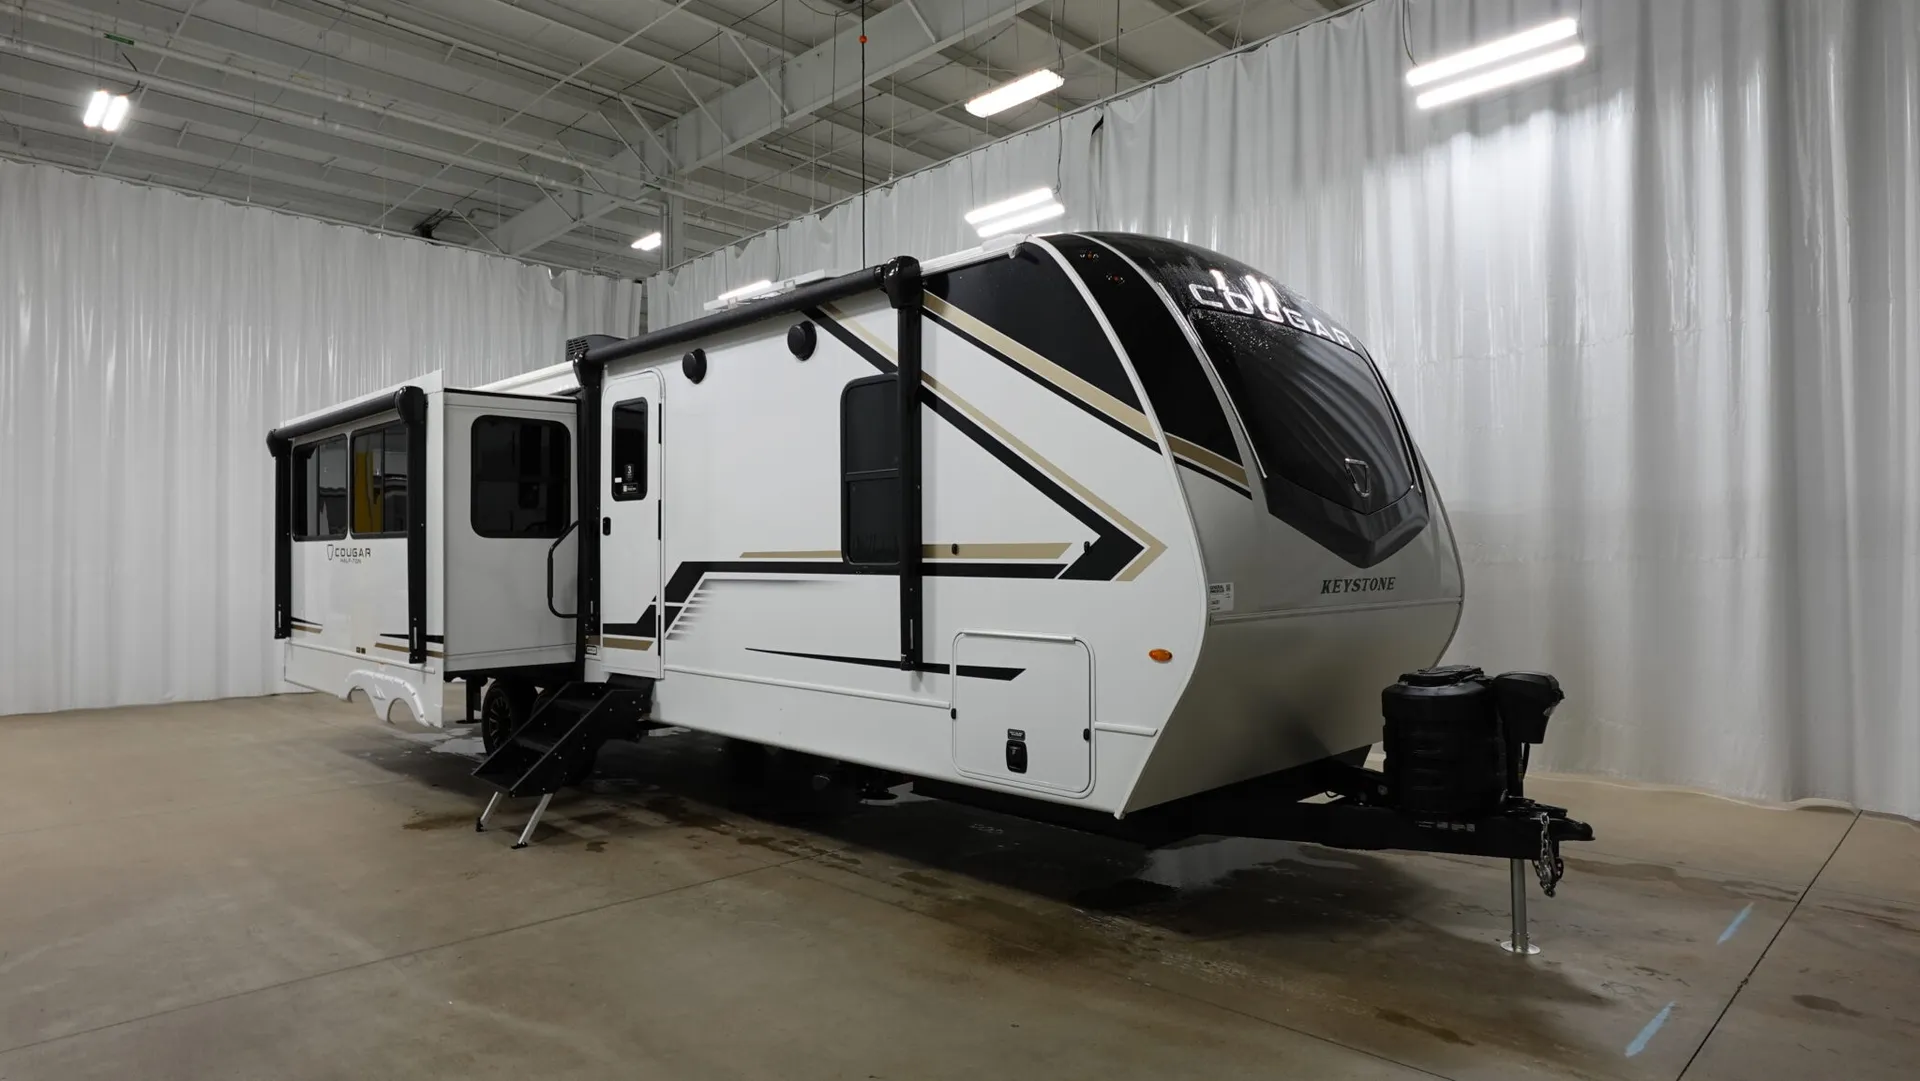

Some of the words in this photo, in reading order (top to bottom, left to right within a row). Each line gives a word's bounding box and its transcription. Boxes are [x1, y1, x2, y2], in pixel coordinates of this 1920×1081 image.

[1188, 283, 1355, 350] COUGAR
[334, 547, 371, 558] COUGAR
[1320, 576, 1396, 595] KEYSTONE
